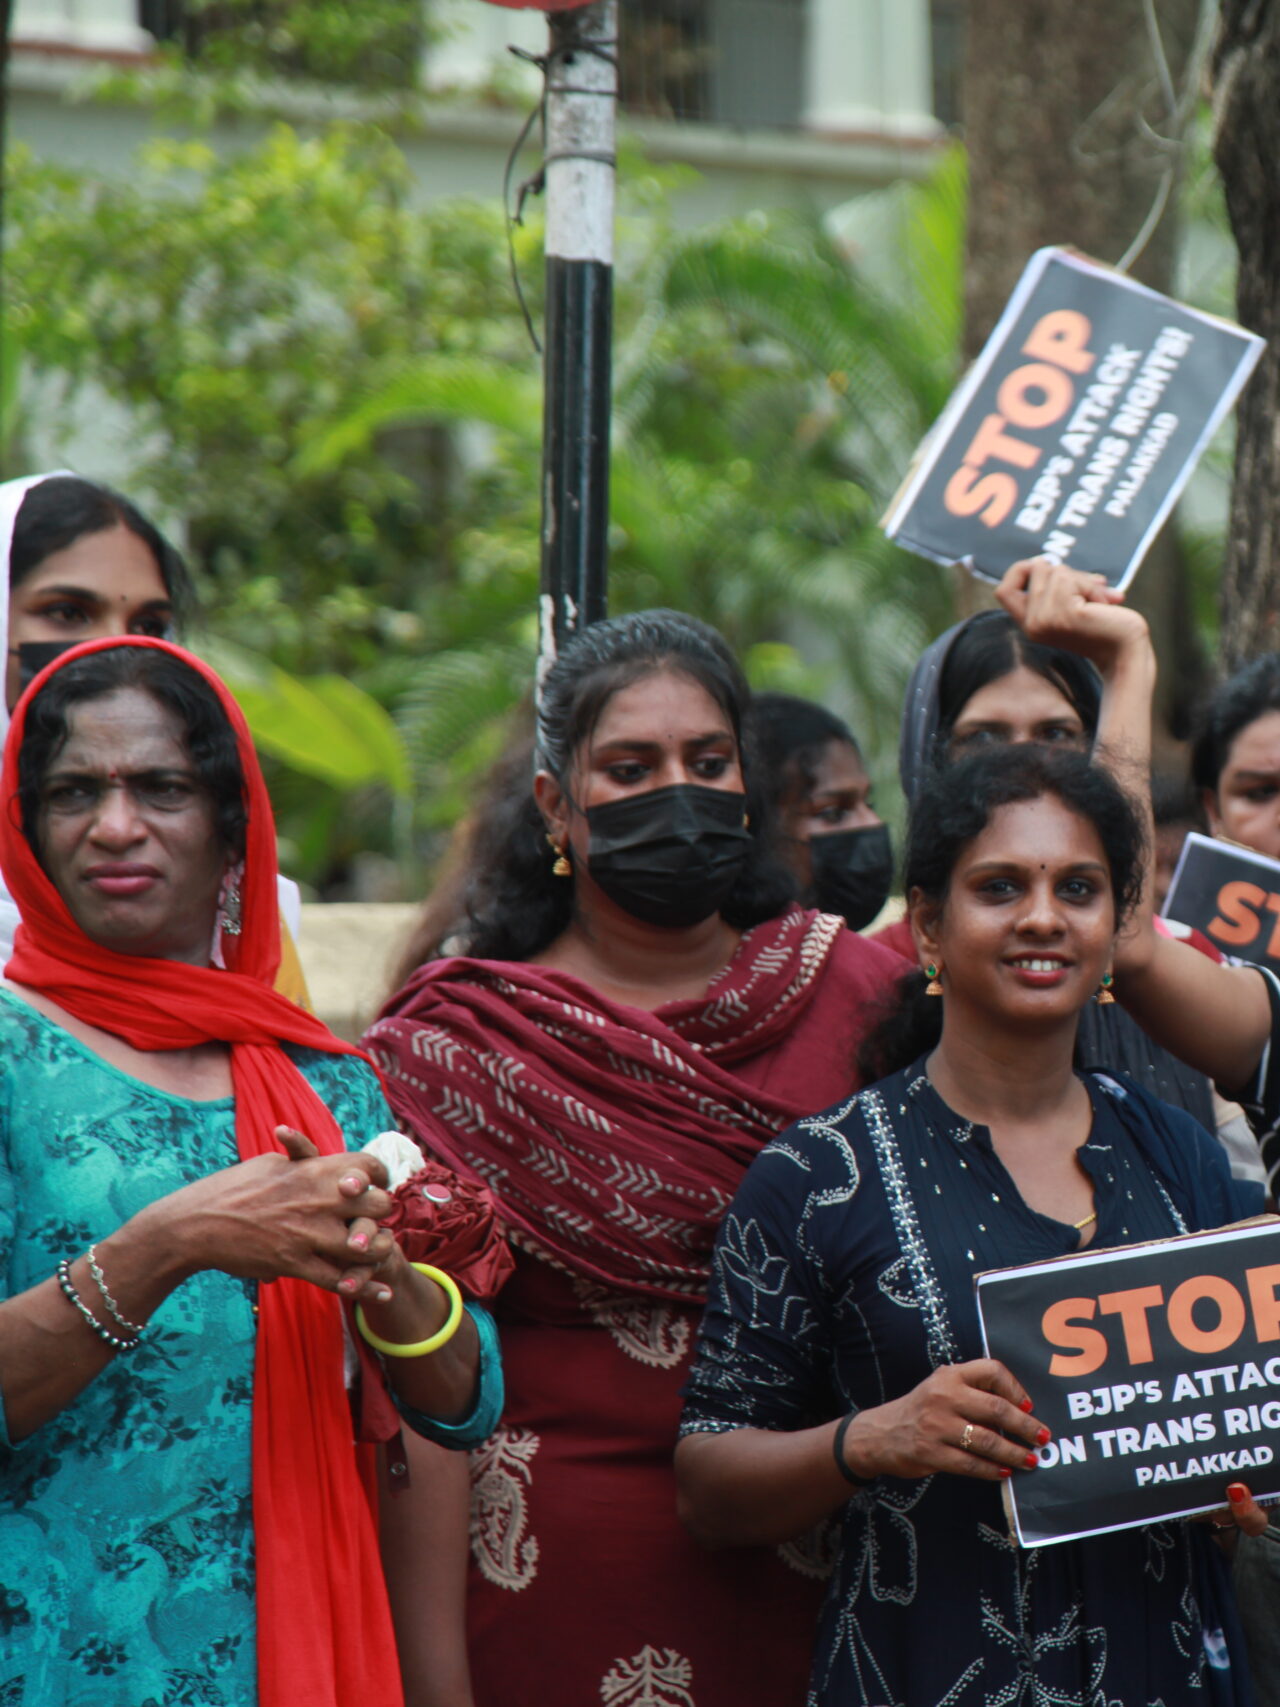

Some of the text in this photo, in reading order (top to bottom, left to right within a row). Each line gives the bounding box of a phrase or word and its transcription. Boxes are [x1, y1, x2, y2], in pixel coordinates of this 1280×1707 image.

[944, 309, 1097, 528] STOP
[1014, 342, 1142, 532] BJP's ATTACK
[1056, 436, 1130, 527] TRANS
[1110, 326, 1194, 436] RIGHTS!
[1104, 412, 1179, 517] PALAKKAD
[1033, 1435, 1087, 1469] ON
[1093, 1413, 1217, 1459] TRANS
[1067, 1379, 1161, 1420] BJP's
[1135, 1446, 1275, 1488] PALAKKAD
